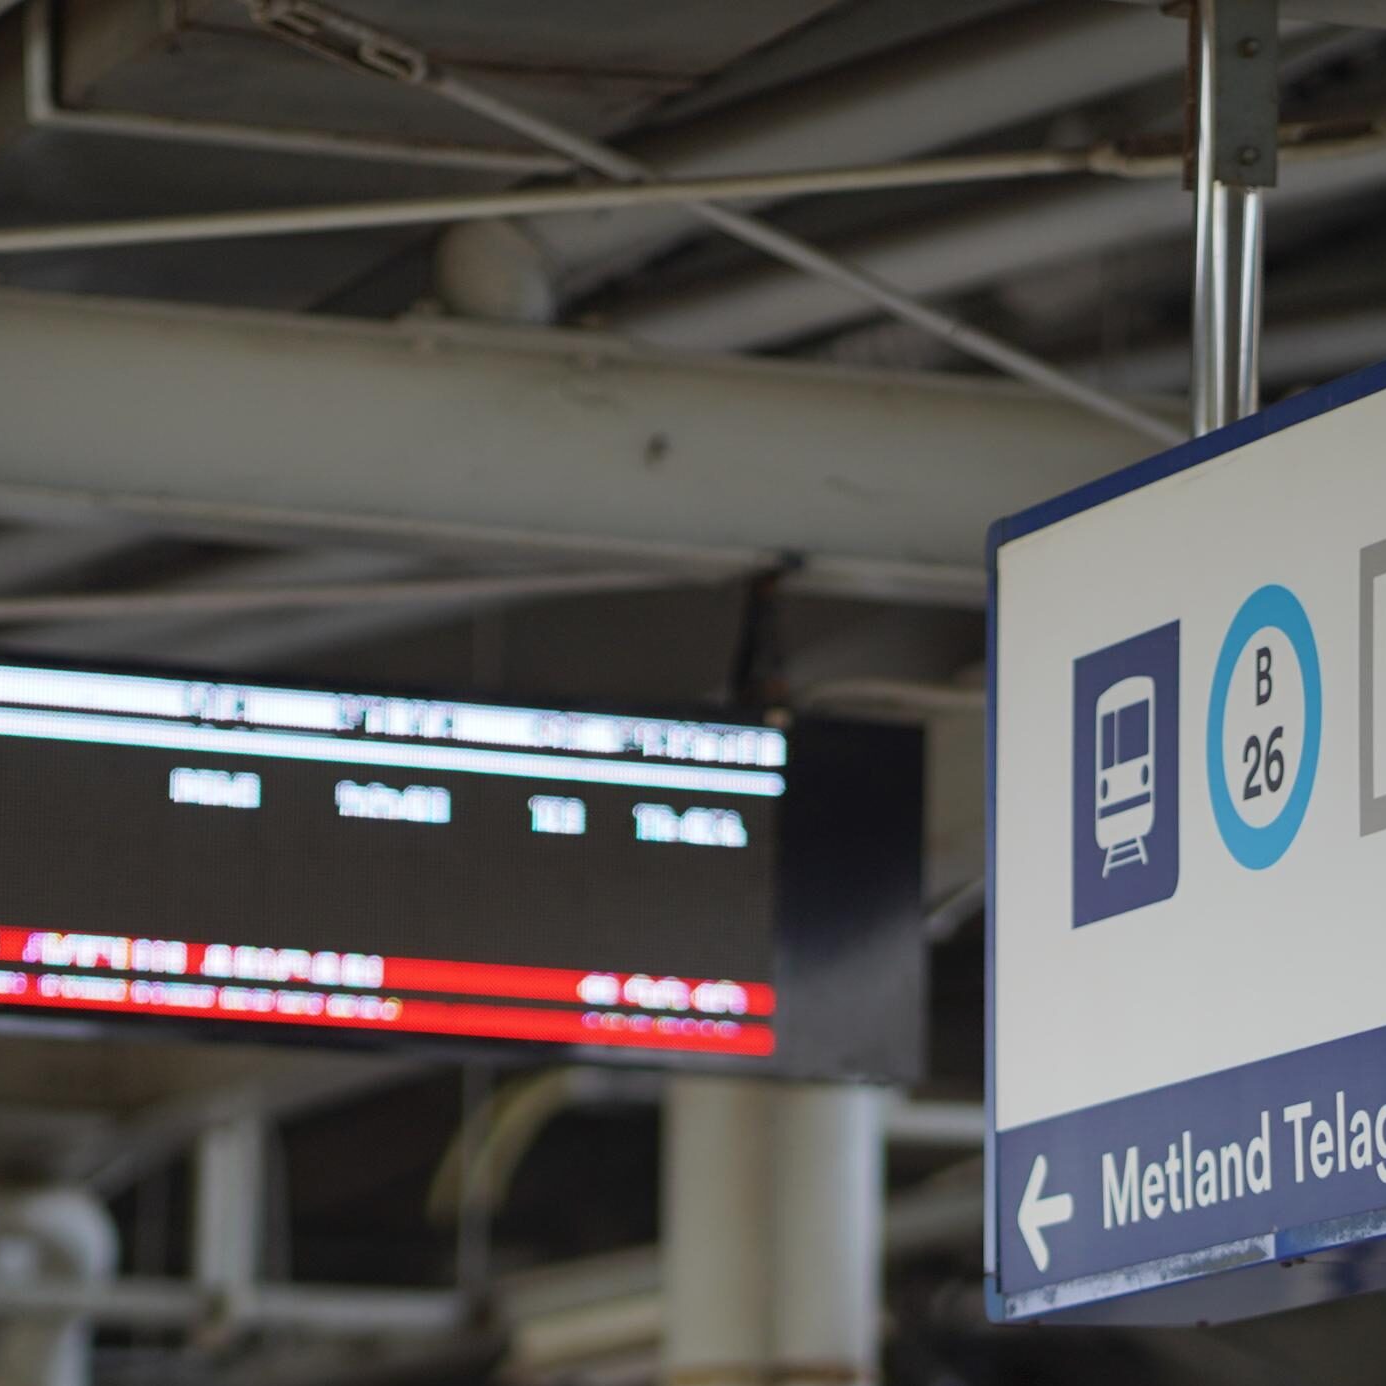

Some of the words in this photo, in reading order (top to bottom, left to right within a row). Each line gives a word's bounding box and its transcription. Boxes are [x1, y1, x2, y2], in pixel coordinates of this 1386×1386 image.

[1255, 647, 1273, 707] B
[1242, 725, 1285, 801] 26
[1101, 1110, 1272, 1230] Metland
